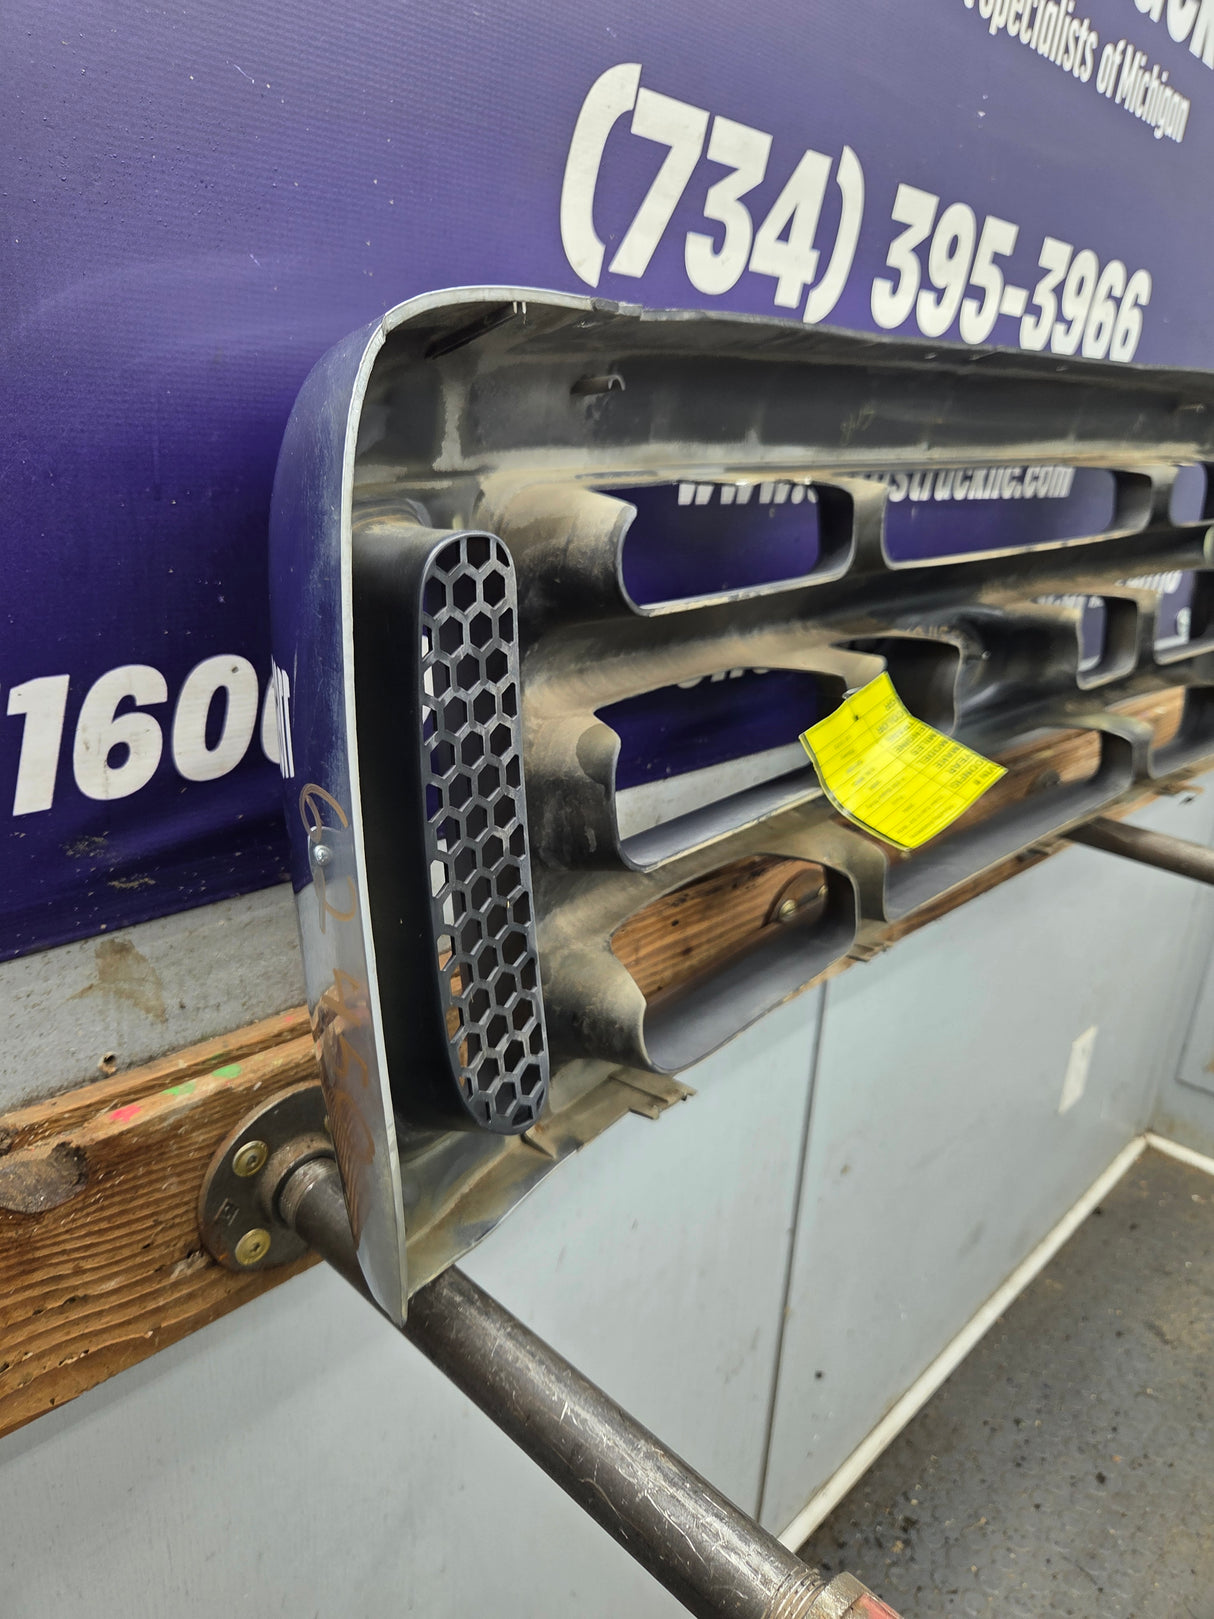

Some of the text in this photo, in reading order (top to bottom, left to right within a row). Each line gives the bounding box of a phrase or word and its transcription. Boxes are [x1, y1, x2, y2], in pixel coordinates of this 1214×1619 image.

[1096, 39, 1127, 98] of
[1115, 44, 1191, 143] Michigan
[560, 63, 1152, 363] (734) 395-3966
[7, 654, 281, 816] 160
[892, 725, 926, 754] ENGINE
[910, 733, 937, 756] MILES
[916, 738, 949, 765] MODEL
[932, 745, 961, 770] MAKE
[946, 753, 973, 774] YEAR
